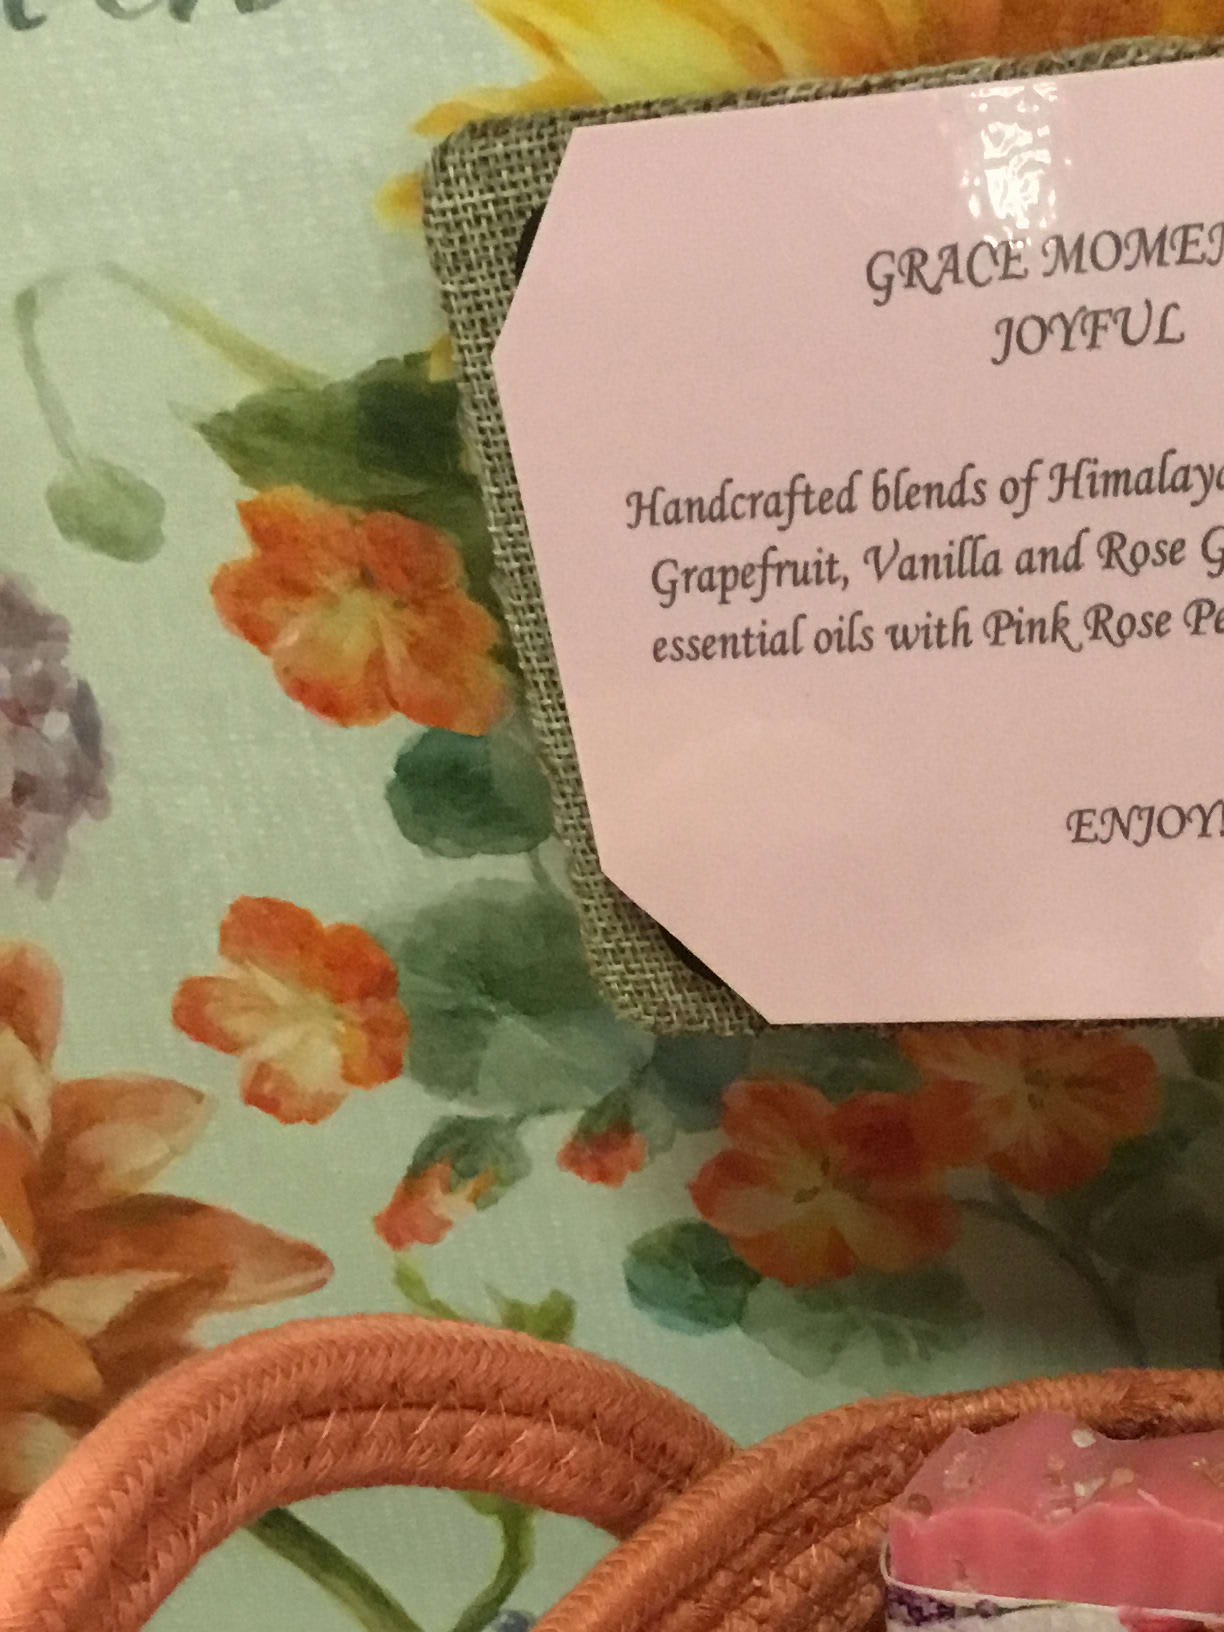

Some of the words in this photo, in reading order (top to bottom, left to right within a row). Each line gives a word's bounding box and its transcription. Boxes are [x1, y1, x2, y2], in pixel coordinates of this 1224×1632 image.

[866, 240, 1029, 308] GRACE
[990, 297, 1186, 366] JOYFUL
[625, 467, 862, 532] Handcrafted
[871, 462, 988, 513] blends
[999, 458, 1044, 520] of
[651, 544, 850, 610] Grapefruit,
[862, 533, 1003, 584] Vanilla
[1014, 526, 1091, 577] and
[1096, 530, 1187, 578] Rose
[652, 612, 808, 664] essential
[813, 609, 875, 655] oils
[884, 606, 974, 652] with
[982, 599, 1083, 653] Pink
[1083, 602, 1172, 649] Rose
